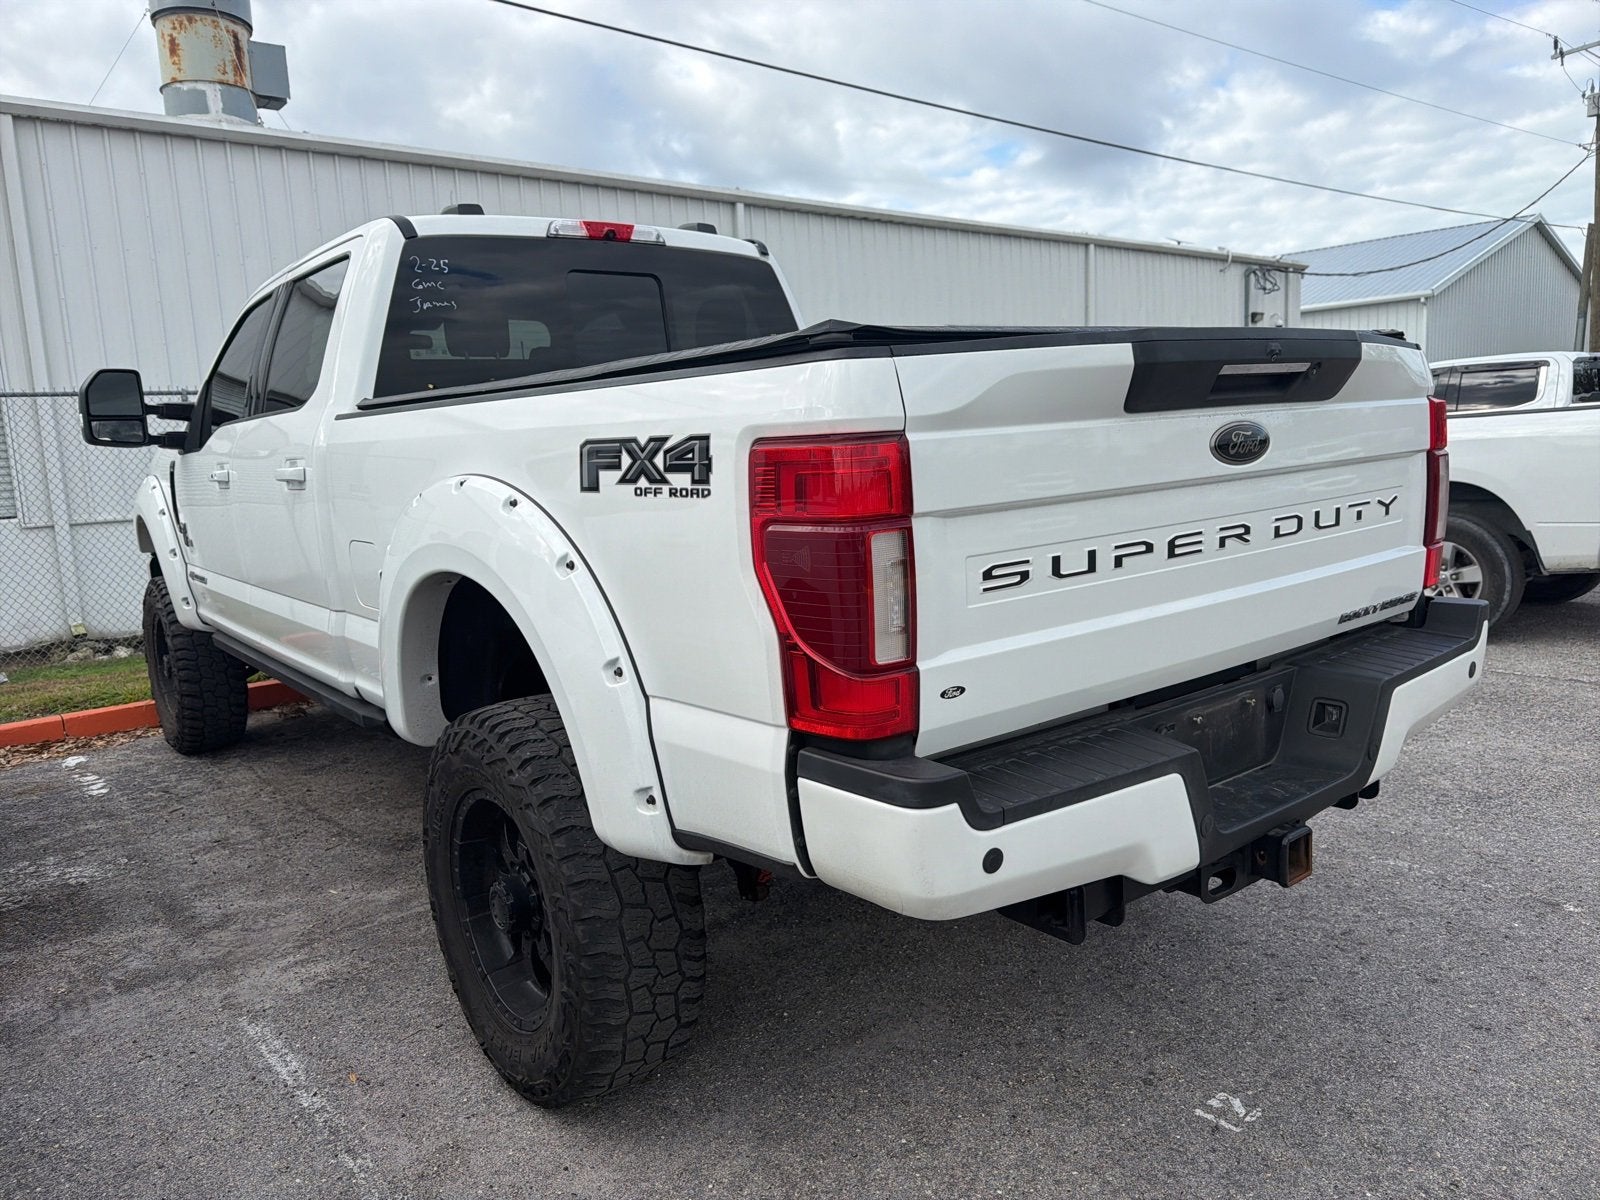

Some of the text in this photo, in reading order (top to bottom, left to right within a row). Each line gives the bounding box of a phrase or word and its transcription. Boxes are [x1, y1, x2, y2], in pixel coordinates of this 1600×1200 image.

[409, 255, 449, 274] 2-25
[1228, 430, 1261, 455] Ford
[579, 432, 713, 494] FX4
[634, 486, 712, 499] OFF ROAD
[980, 494, 1399, 594] SUPER DUTY
